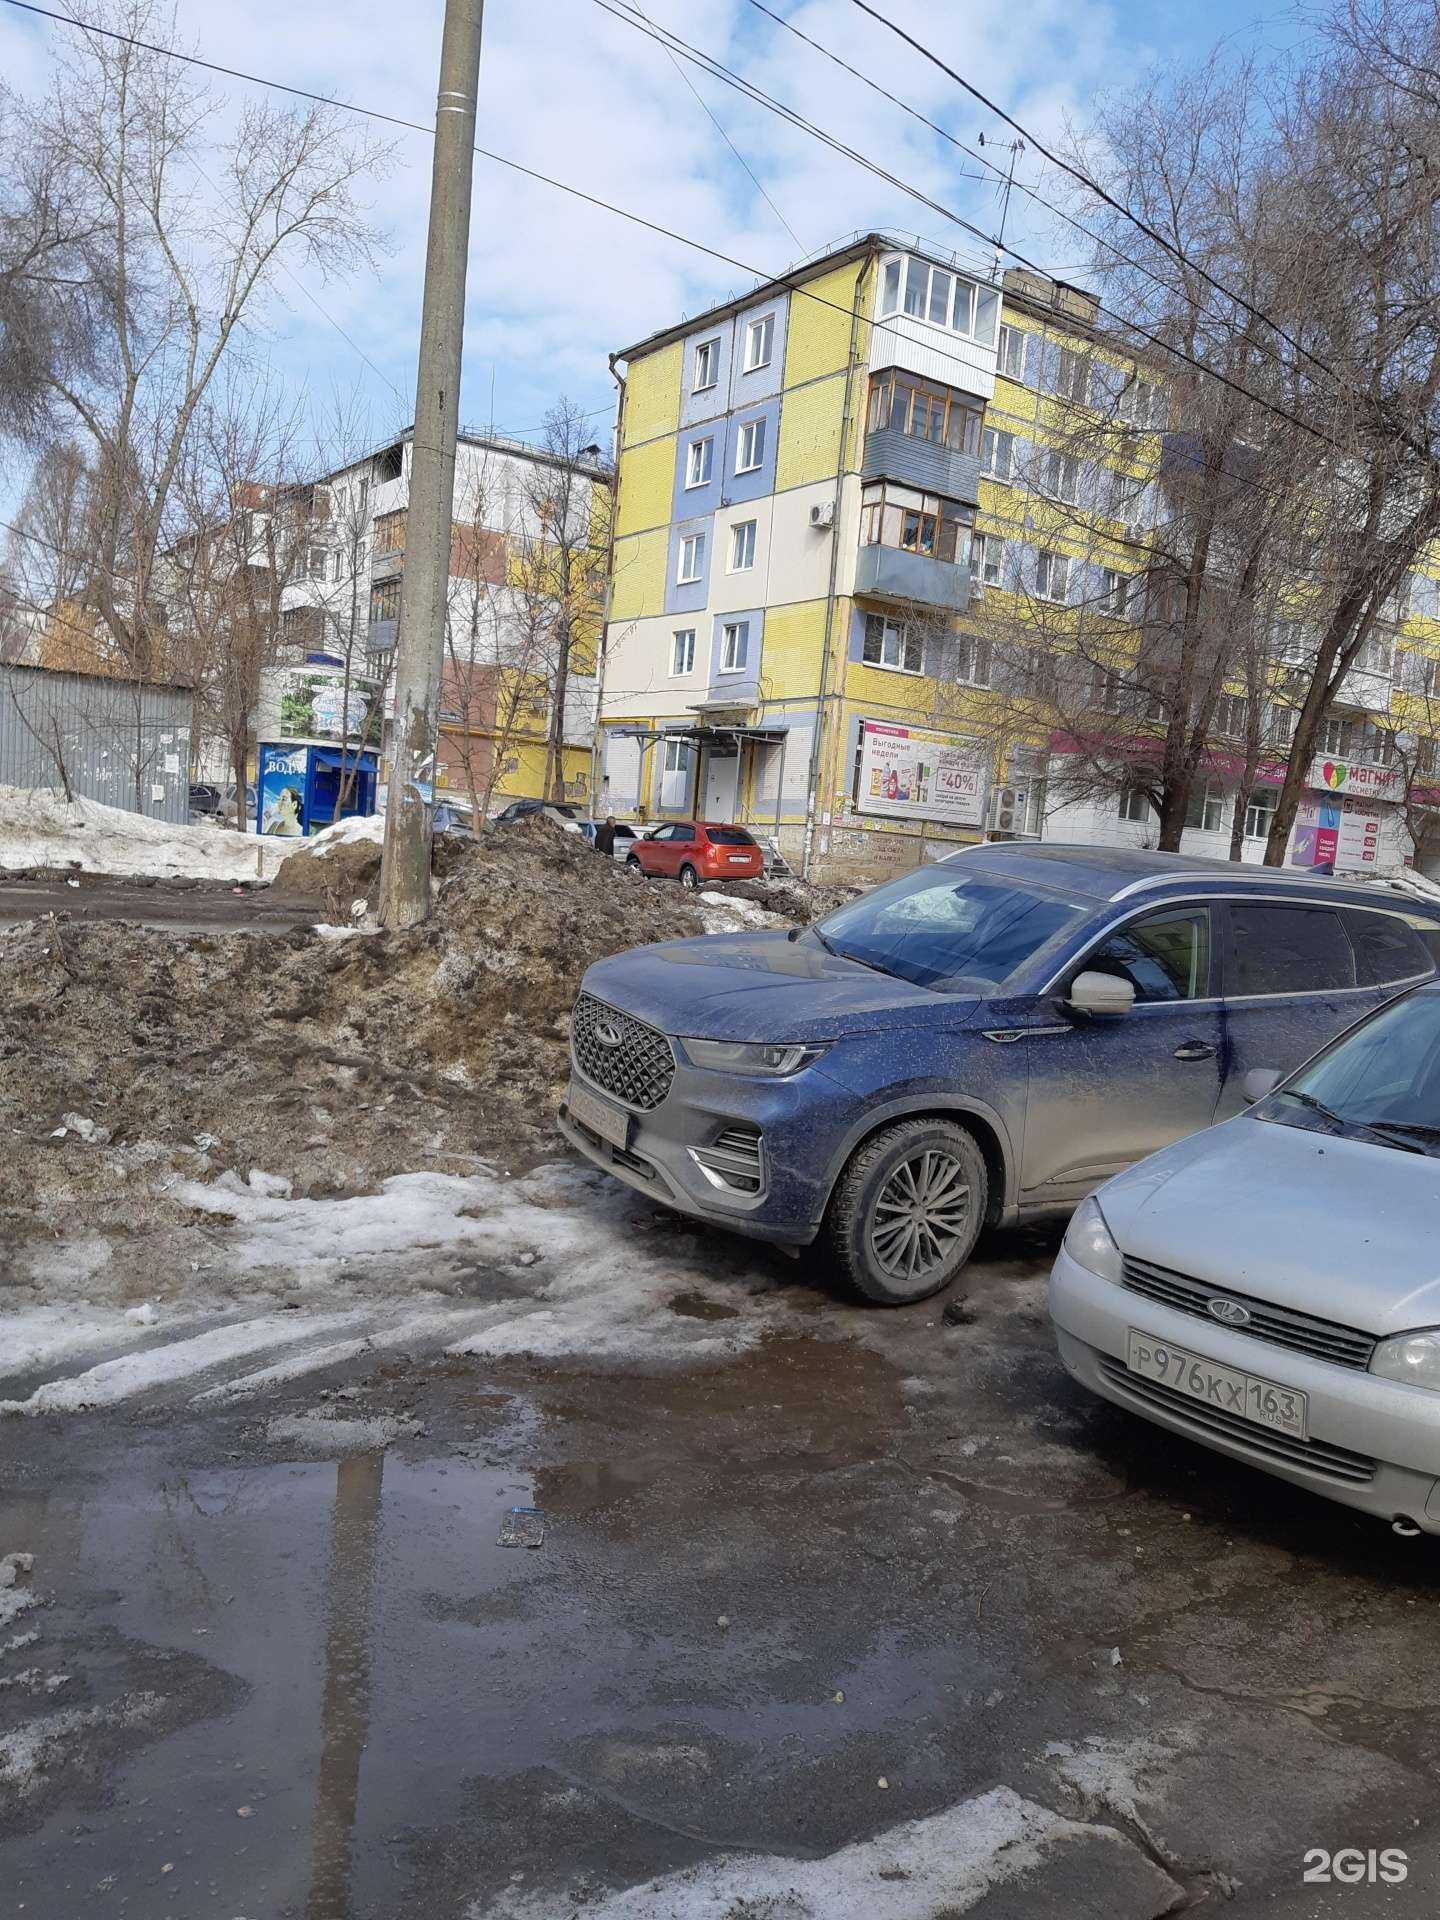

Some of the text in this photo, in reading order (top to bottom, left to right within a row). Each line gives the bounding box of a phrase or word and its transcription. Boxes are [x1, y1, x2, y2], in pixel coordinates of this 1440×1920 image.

[872, 738, 911, 752] Выгодные
[872, 749, 899, 760] недели
[941, 773, 974, 791] -40%
[1137, 1346, 1296, 1420] Р976КХ 163
[1259, 1409, 1282, 1425] RUS
